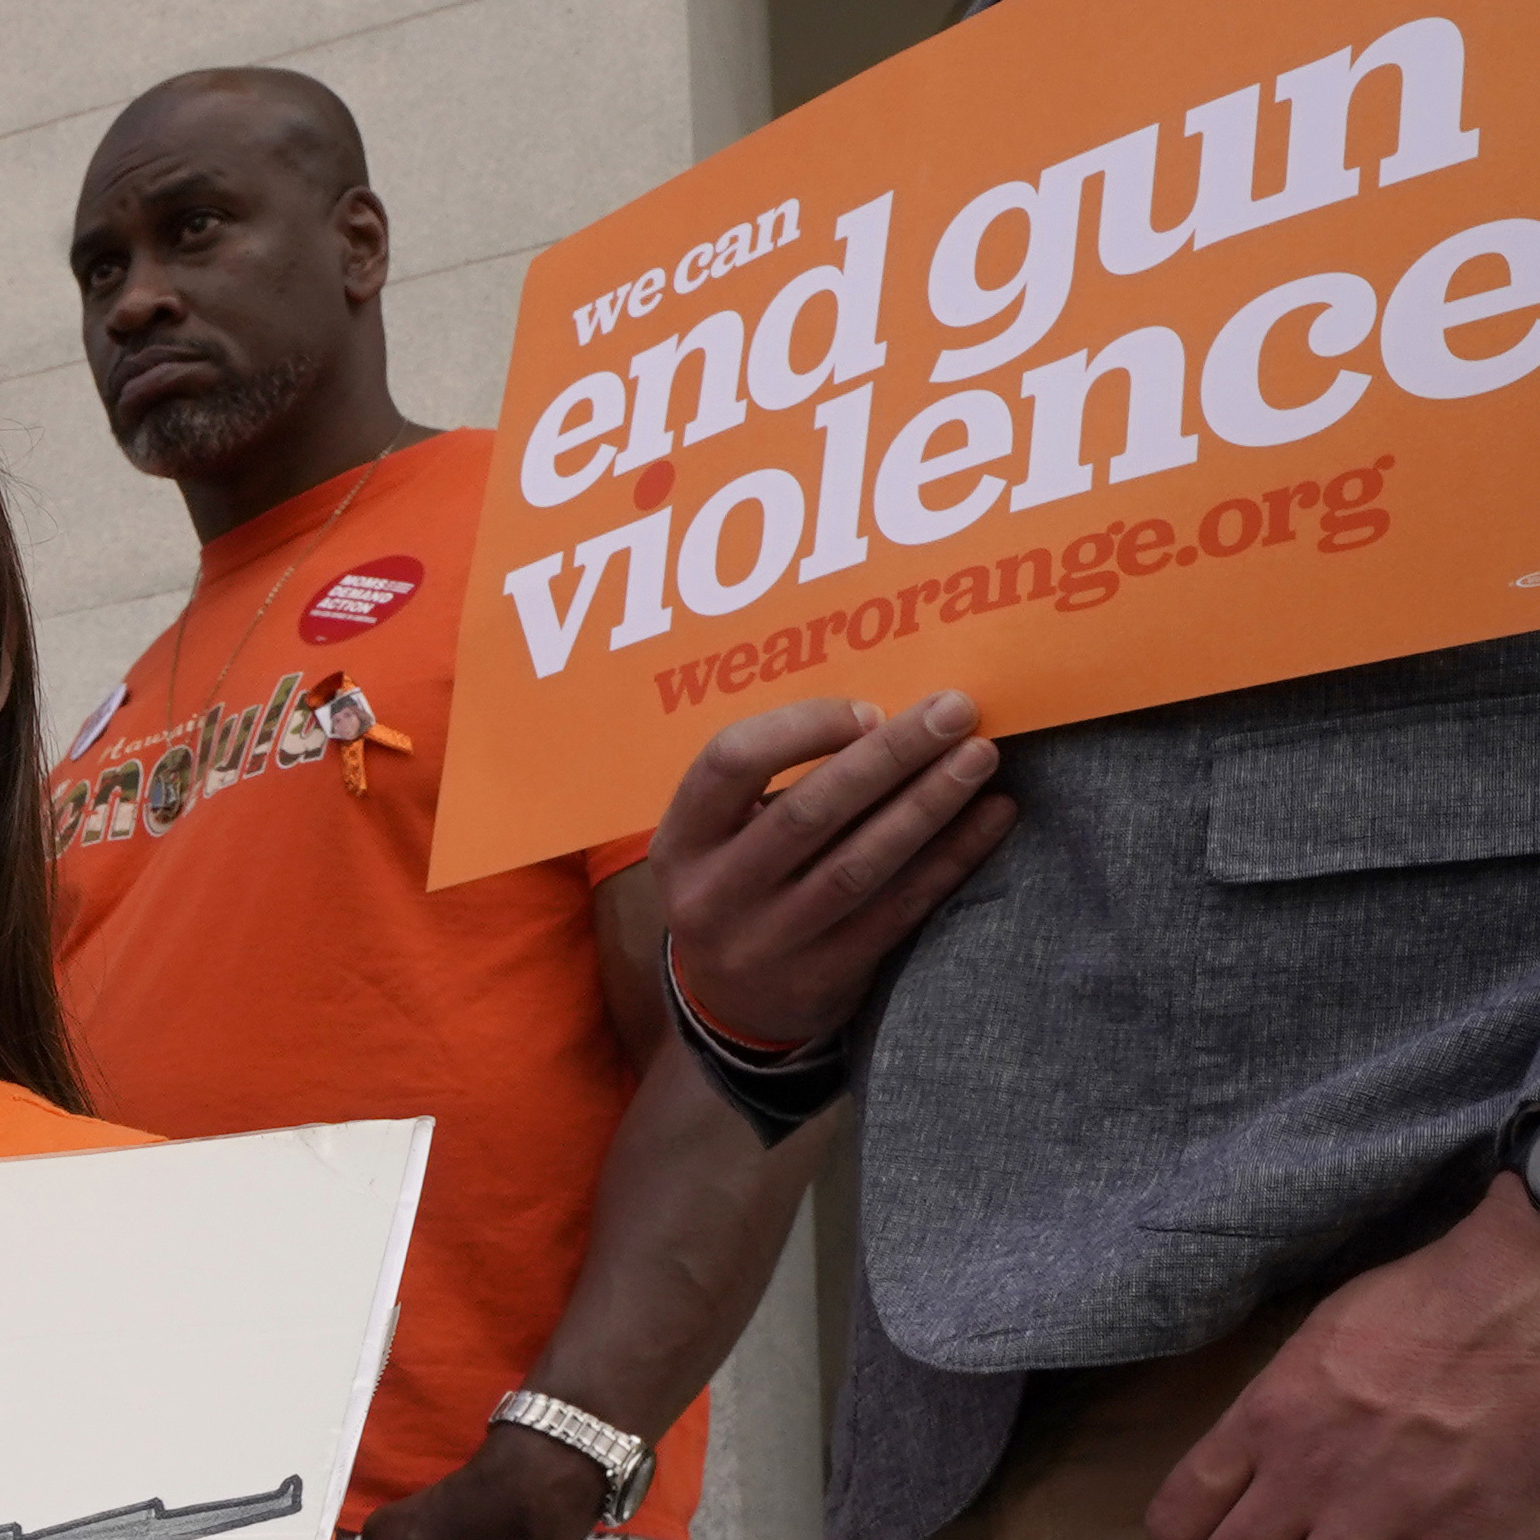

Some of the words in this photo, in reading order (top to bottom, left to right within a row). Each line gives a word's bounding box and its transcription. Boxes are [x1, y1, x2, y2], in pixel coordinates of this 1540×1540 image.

[520, 189, 894, 508] end
[927, 16, 1480, 384] gun
[572, 266, 667, 347] we
[672, 197, 802, 295] can
[502, 217, 1540, 679] violence
[316, 597, 376, 614] ACTION
[653, 453, 1396, 715] wearorange.org
[45, 671, 329, 862] onolulu
